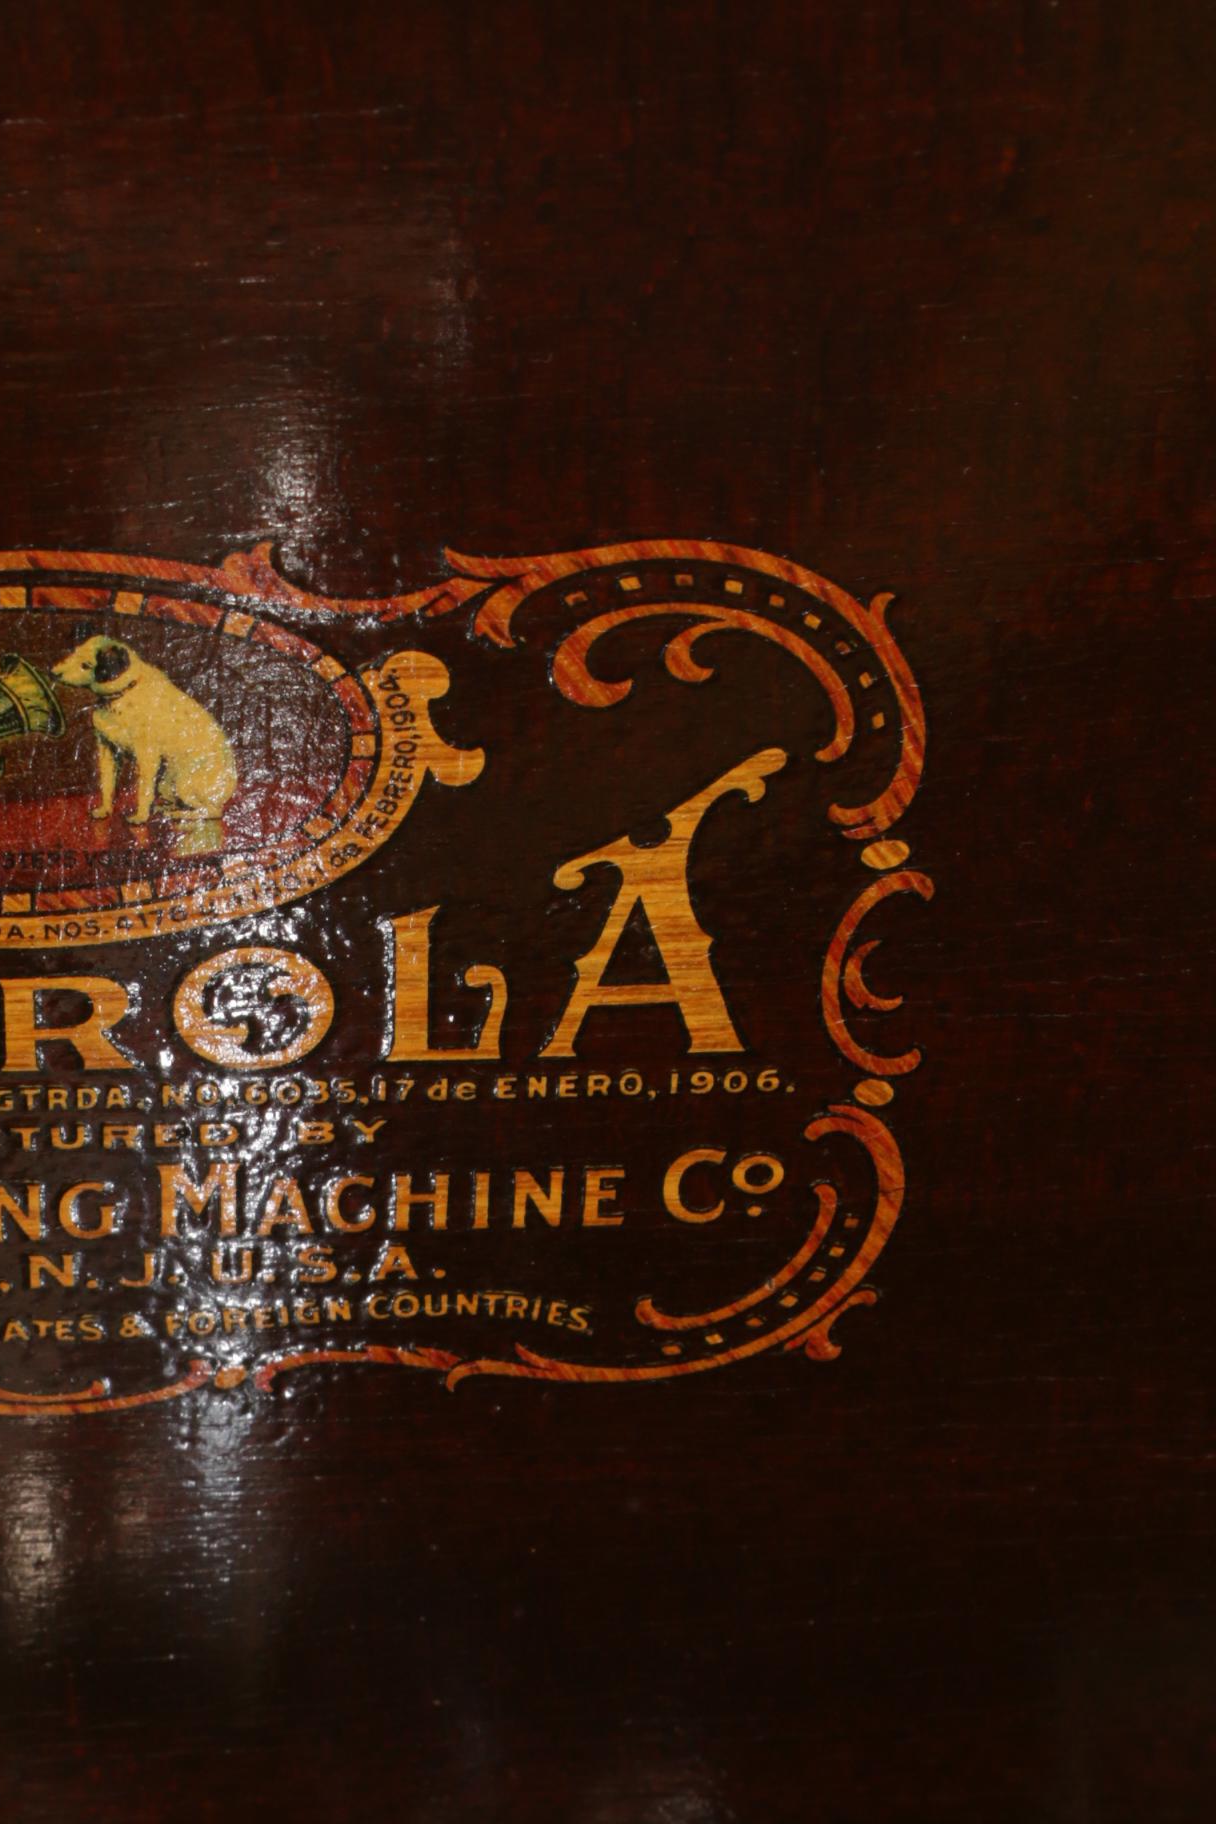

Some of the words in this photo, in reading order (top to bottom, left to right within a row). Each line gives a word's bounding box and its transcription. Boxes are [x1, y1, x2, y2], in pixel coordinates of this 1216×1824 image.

[427, 1079, 477, 1100] de
[298, 1119, 387, 1145] BY
[156, 1163, 626, 1238] MACHINE
[119, 1317, 142, 1339] &
[167, 1298, 352, 1337] FOREIGN
